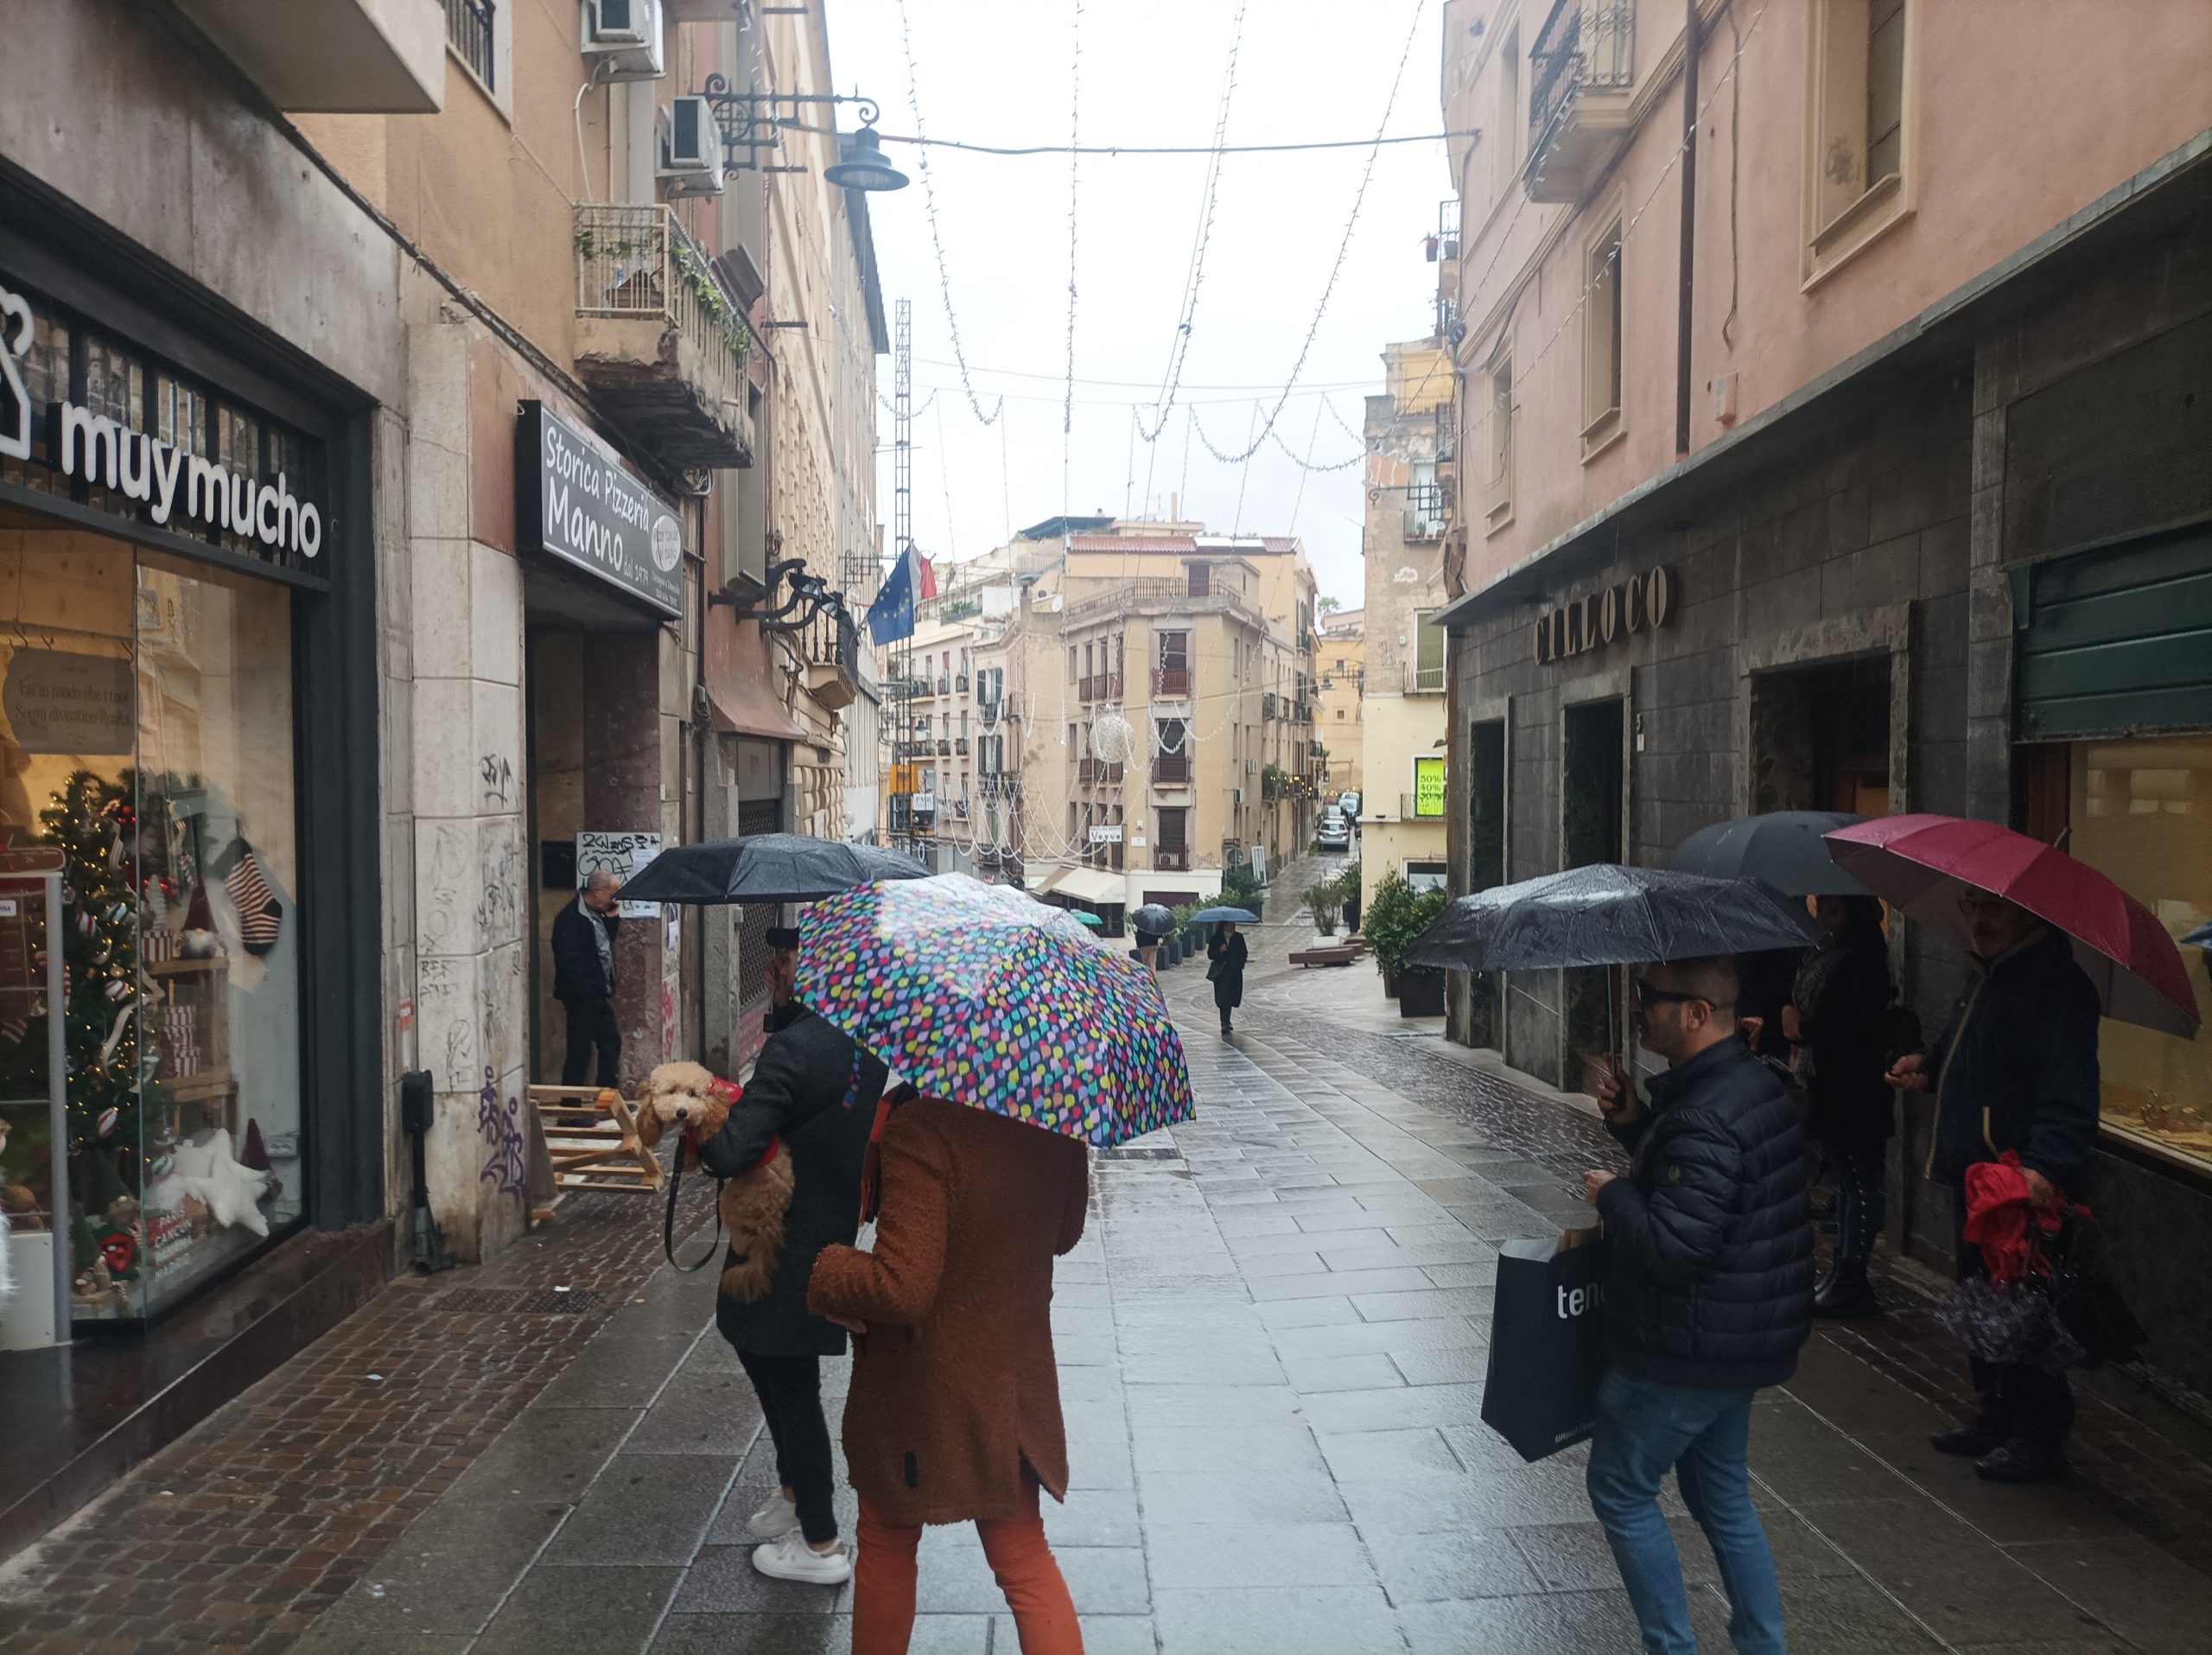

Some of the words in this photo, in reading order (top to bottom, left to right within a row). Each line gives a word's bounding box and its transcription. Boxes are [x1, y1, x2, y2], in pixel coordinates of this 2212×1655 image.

[546, 426, 600, 500] Storica
[605, 469, 650, 533] Pizzeria
[548, 476, 623, 572] Manno
[623, 553, 633, 580] dal
[635, 564, 649, 587] 1979
[1534, 565, 1667, 665] CILLOCO
[1420, 774, 1441, 783] 50%
[1421, 783, 1441, 792] 40%
